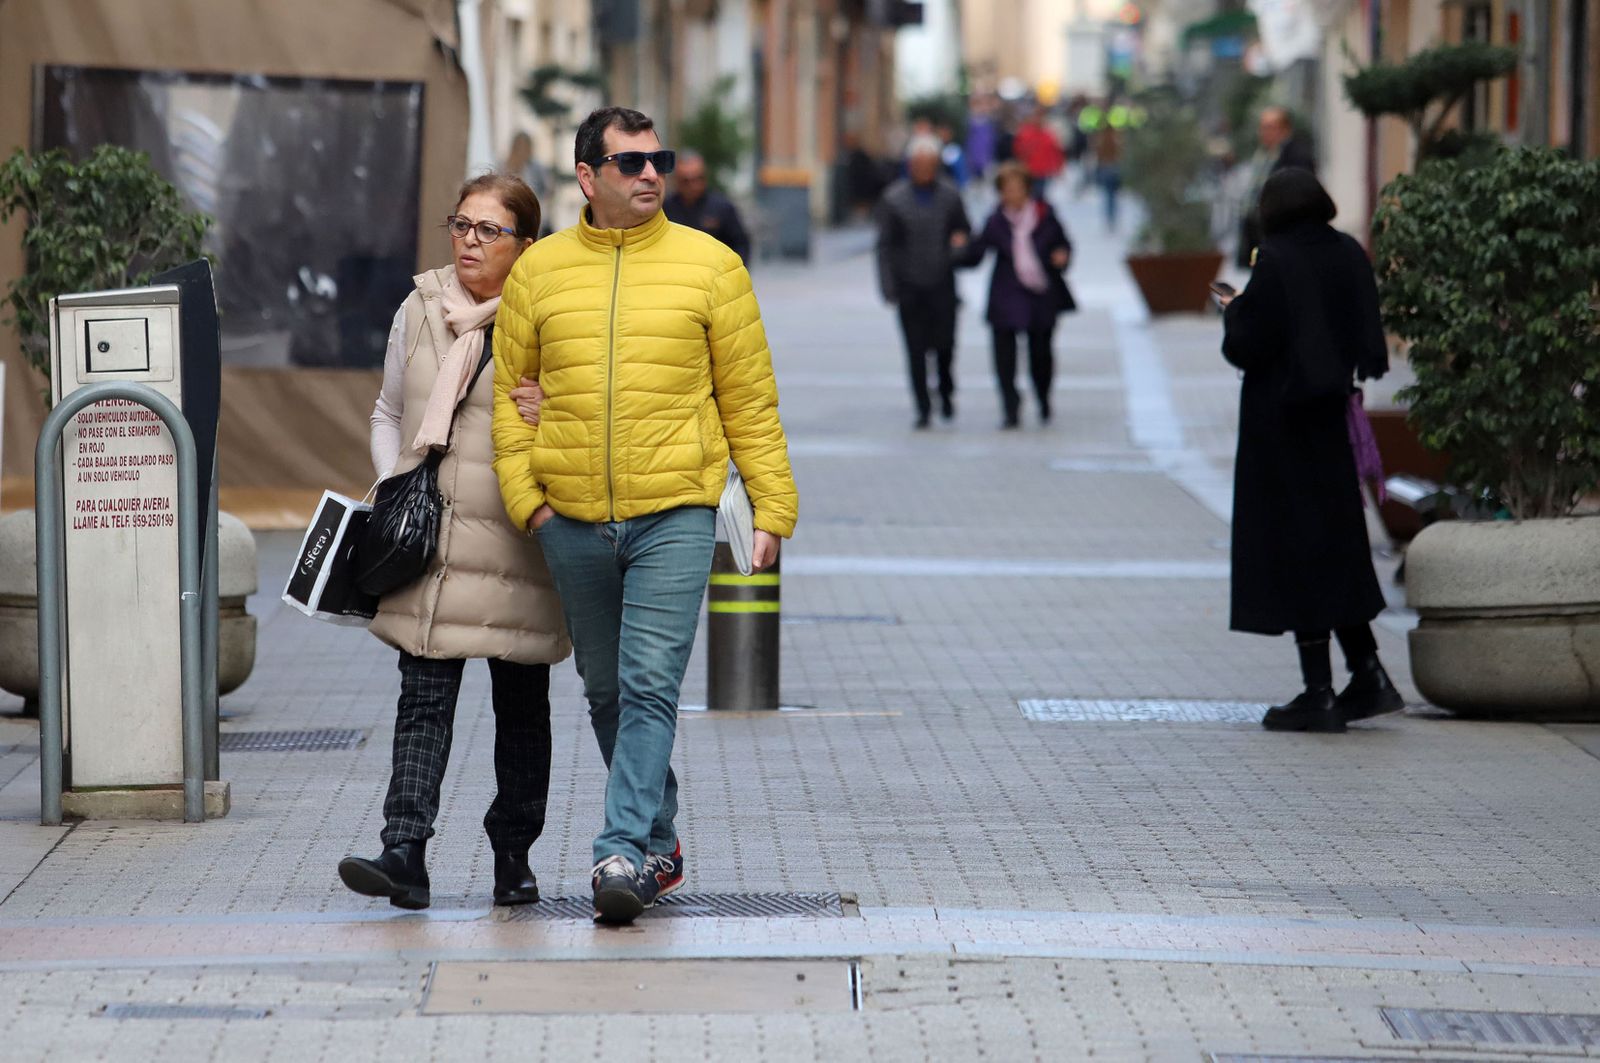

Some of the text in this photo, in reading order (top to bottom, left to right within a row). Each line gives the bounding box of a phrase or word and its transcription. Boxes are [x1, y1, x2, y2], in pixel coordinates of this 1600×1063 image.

[77, 410, 161, 424] SOLO VEHICULOS AUTORIZA
[78, 426, 160, 438] NO PASE CON EL SEMAFORO
[79, 442, 105, 454] EN ROJO
[78, 454, 174, 468] CADA BAJADA DE BOLARDO PASO
[78, 470, 140, 482] A UN SOLO VEHICULO
[76, 498, 170, 512] PARA CUALQUIER AVERIA
[74, 516, 98, 530] LLAME
[100, 516, 110, 528] AL
